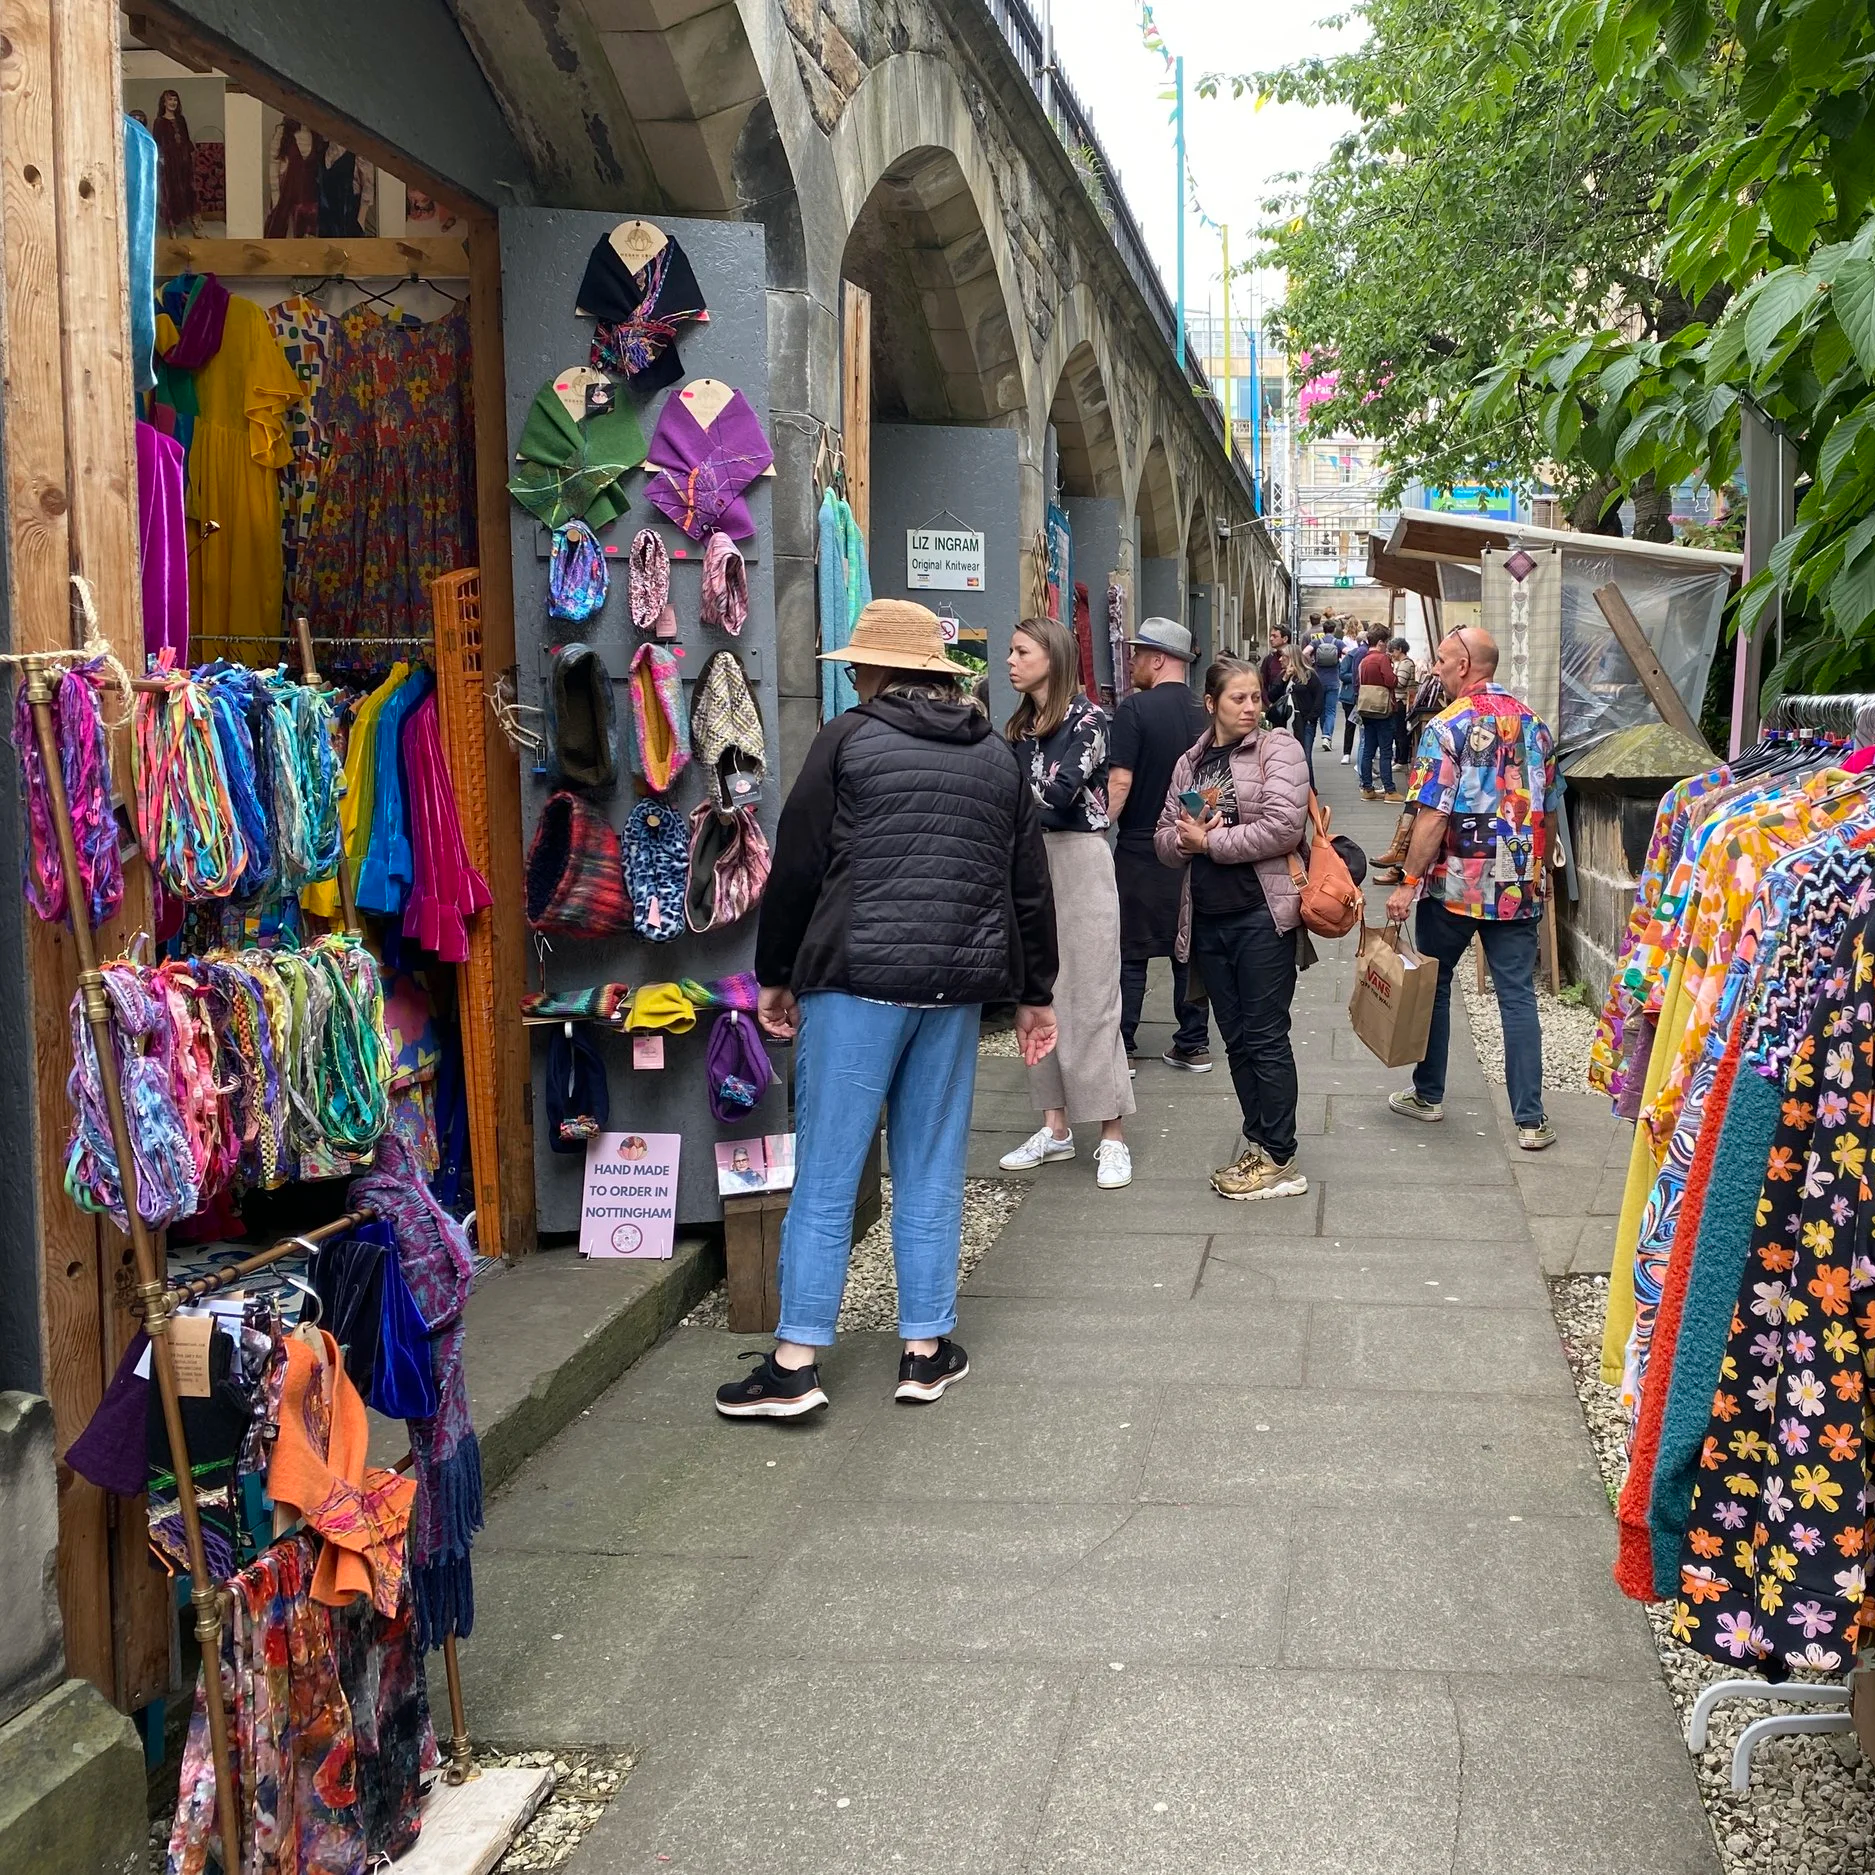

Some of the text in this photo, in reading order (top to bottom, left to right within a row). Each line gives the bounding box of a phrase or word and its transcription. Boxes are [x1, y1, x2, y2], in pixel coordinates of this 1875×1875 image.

[912, 535, 979, 552] LIZ INGRAM
[912, 558, 980, 572] Original Knitwear
[1367, 965, 1392, 998] VANS
[594, 1164, 670, 1176] HAND MADE
[589, 1185, 668, 1197] TO ORDER IN
[586, 1207, 672, 1218] NOTTINGHAM
